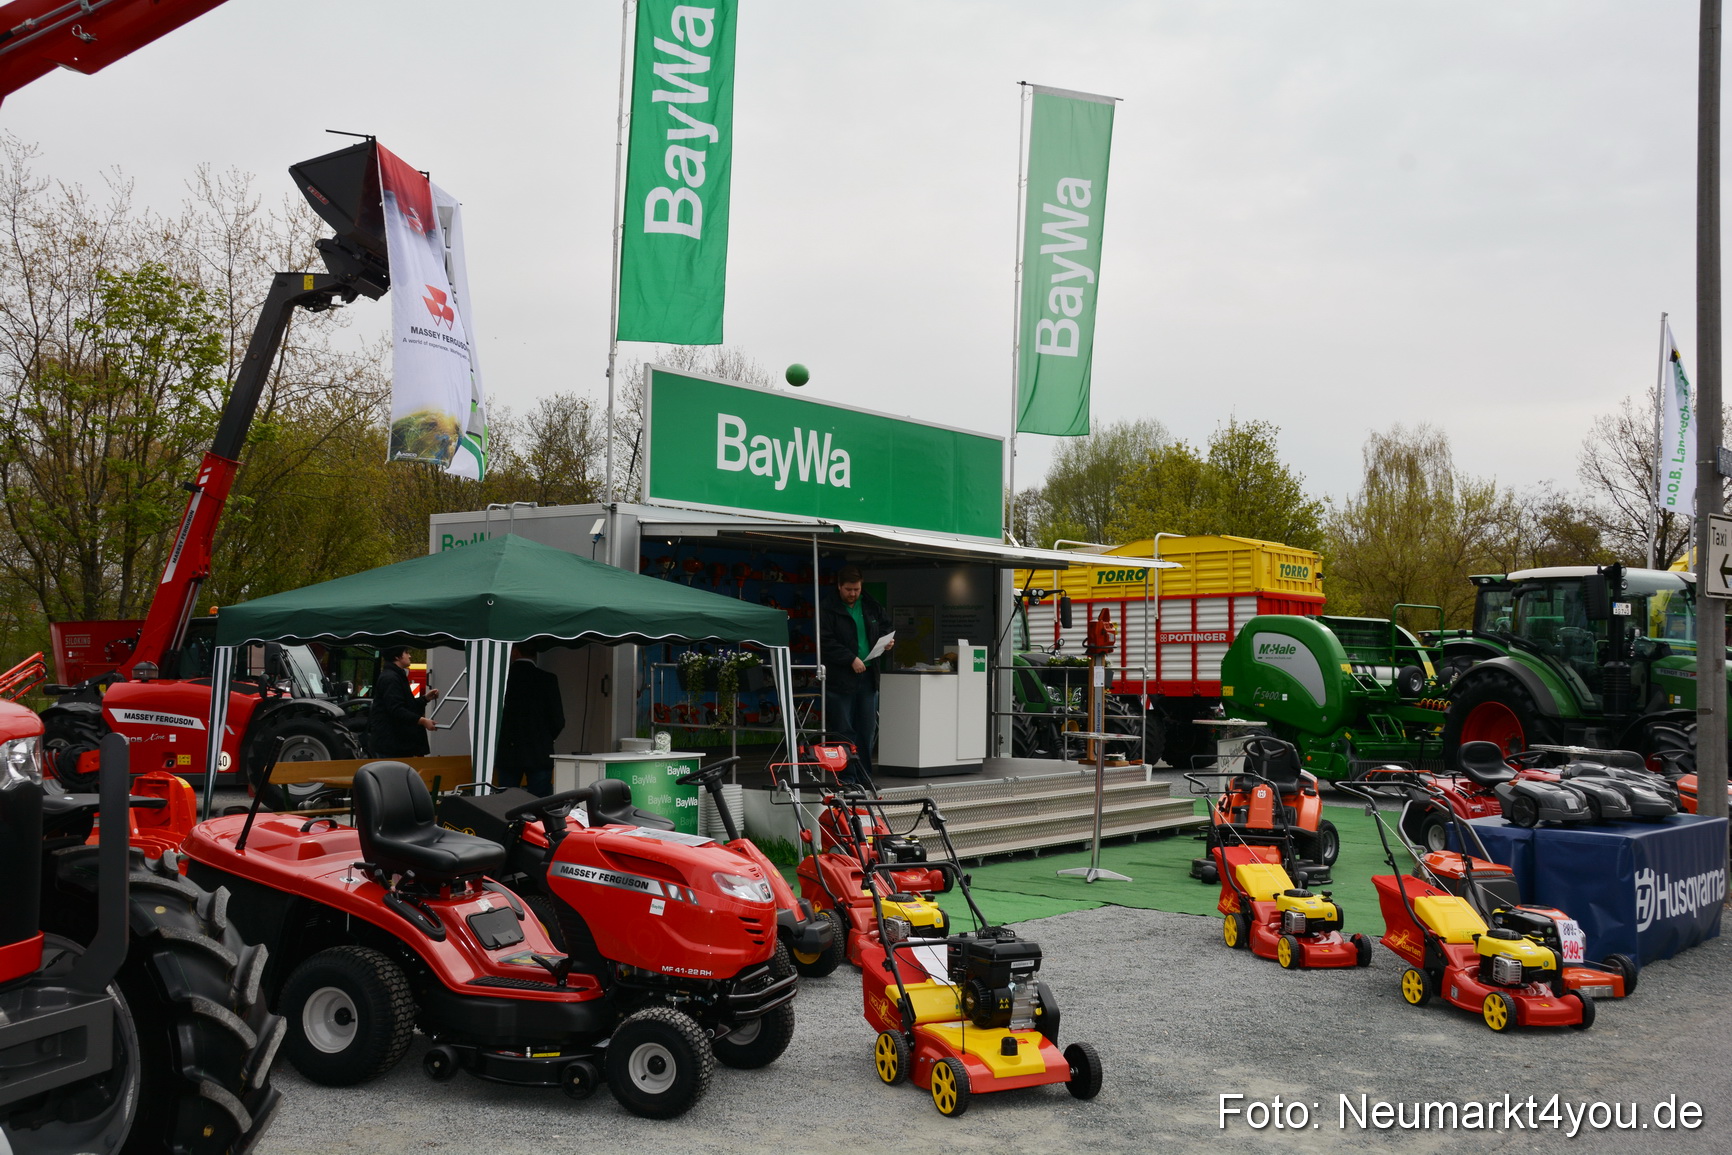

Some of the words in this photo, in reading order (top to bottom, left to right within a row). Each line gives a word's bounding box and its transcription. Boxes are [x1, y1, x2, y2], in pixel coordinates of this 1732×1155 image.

[643, 4, 719, 240] BayWa
[1035, 176, 1095, 358] BayWa
[410, 326, 440, 340] MASSEY
[442, 333, 469, 351] FERGUSO
[716, 412, 851, 491] BayWa
[172, 540, 184, 564] MASSEY
[180, 509, 195, 540] FERGUSON
[1711, 526, 1727, 547] Taxi
[1097, 568, 1146, 585] TORRO
[1280, 563, 1309, 578] TORRO
[65, 637, 91, 646] SILOKING
[1258, 644, 1297, 655] McHale
[124, 712, 154, 721] MASSEY
[155, 714, 195, 726] FERGUSON
[667, 765, 691, 776] BayWa
[632, 775, 657, 786] BayWa
[648, 795, 672, 806] BayWa
[676, 796, 698, 808] BayWa
[560, 865, 597, 879] MASSEY
[598, 872, 649, 890] FERGUSON
[1656, 868, 1725, 920] Husqvarna
[1401, 941, 1422, 957] Garten
[661, 965, 674, 973] MF
[674, 966, 699, 976] 41-22
